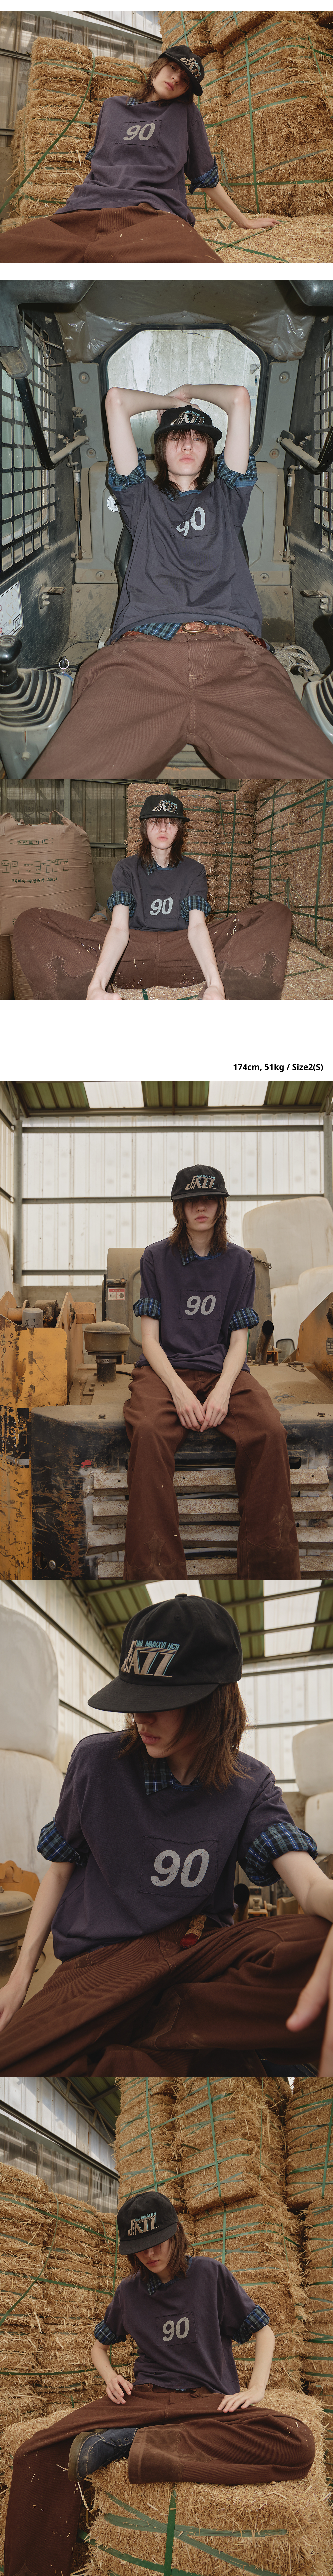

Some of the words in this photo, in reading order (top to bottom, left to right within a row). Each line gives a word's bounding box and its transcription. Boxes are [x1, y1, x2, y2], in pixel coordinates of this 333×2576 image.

[123, 123, 155, 140] 90
[176, 507, 206, 537] 90
[150, 897, 173, 915] 90
[185, 1175, 216, 1190] JAZZ
[185, 1295, 216, 1315] 90
[121, 1640, 175, 1677] JAZZ
[151, 1849, 209, 1888] 90
[128, 2217, 159, 2236] JAZZ
[163, 2317, 189, 2341] 90
